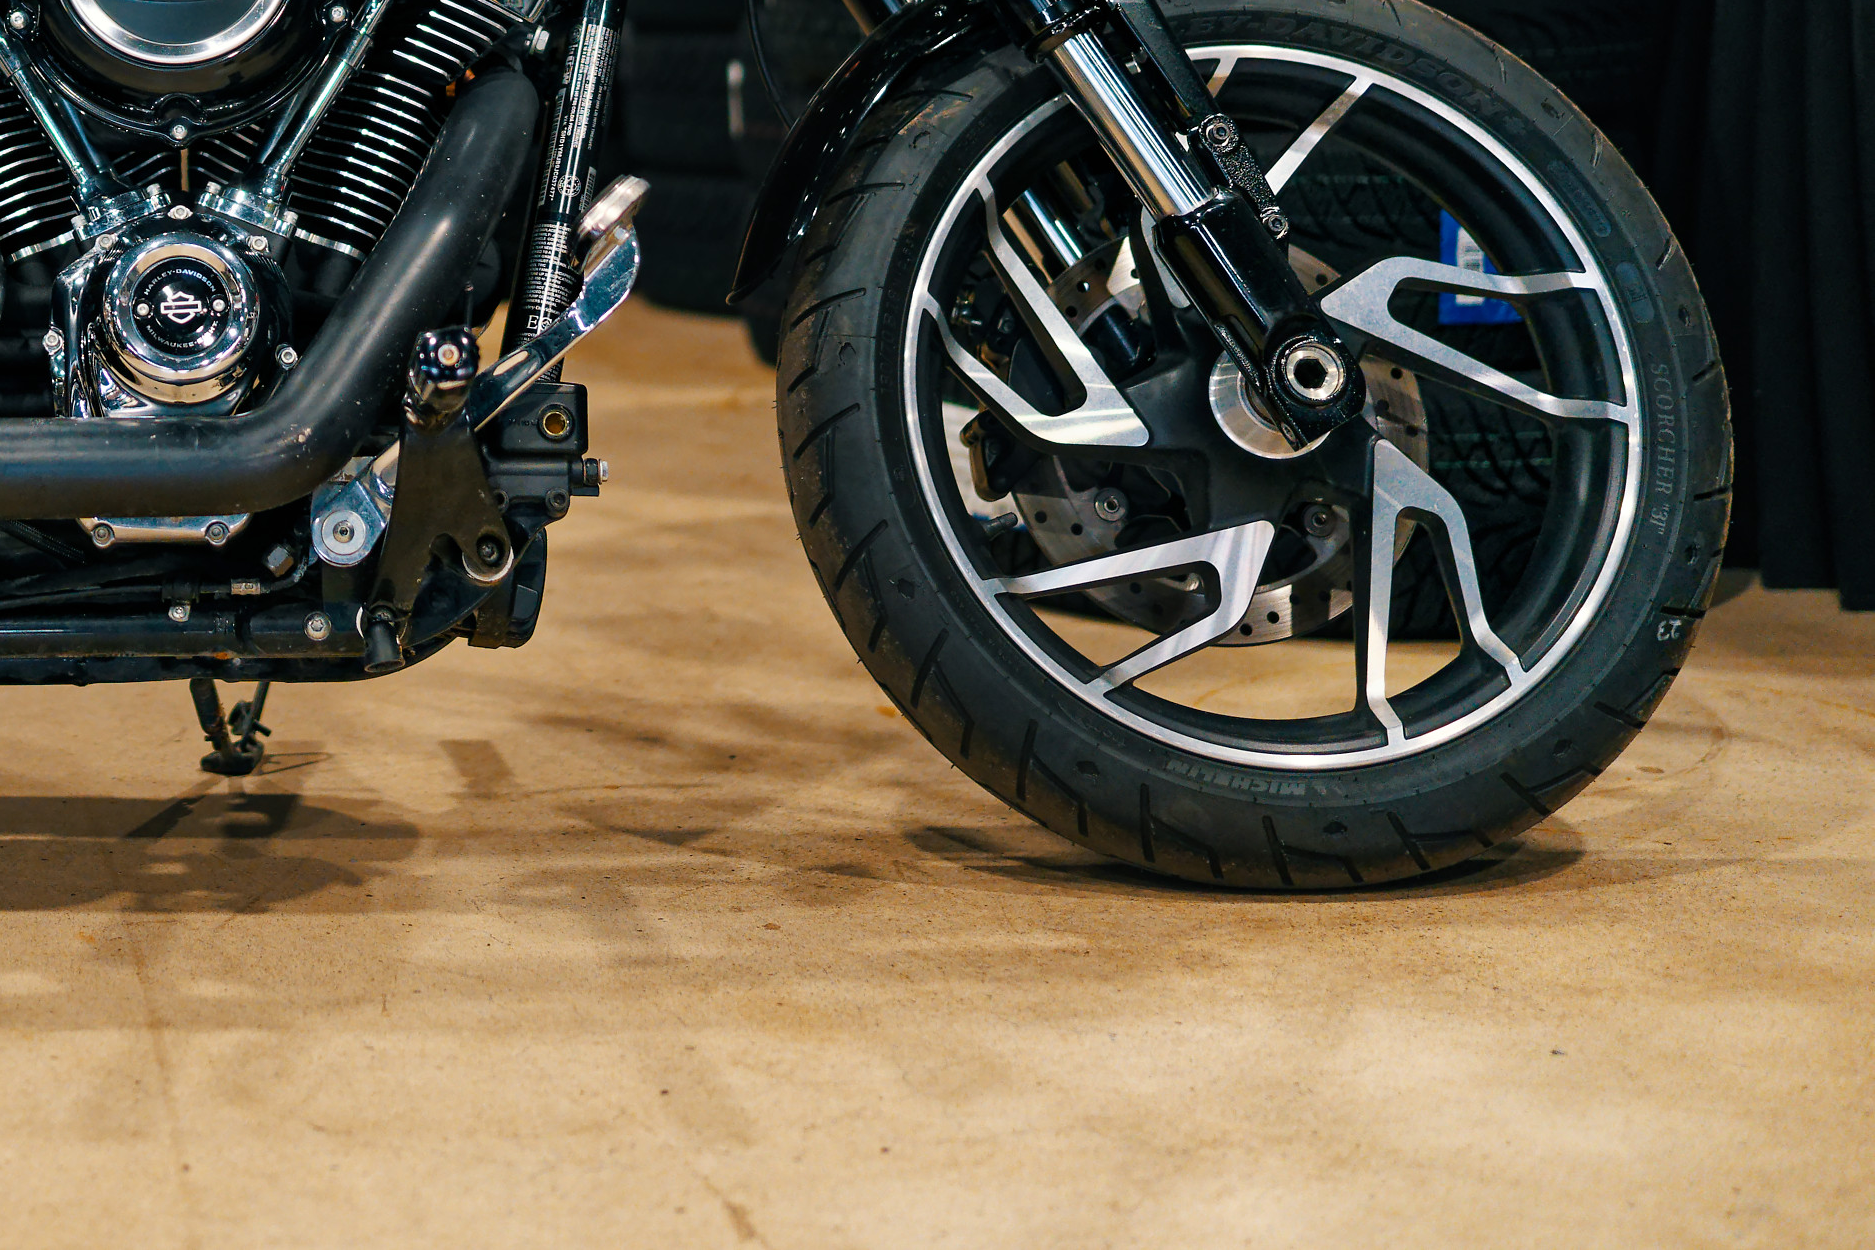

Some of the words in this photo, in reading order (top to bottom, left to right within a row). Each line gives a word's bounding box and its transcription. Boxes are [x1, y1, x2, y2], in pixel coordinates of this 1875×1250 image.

[1175, 11, 1510, 118] EY-DAVIDSON
[143, 268, 216, 296] HARLEY-DAVIDSON
[145, 320, 219, 349] MILWAUKEE-EHT
[1650, 363, 1676, 498] SCORCHER
[1166, 758, 1306, 796] MICHELIN
